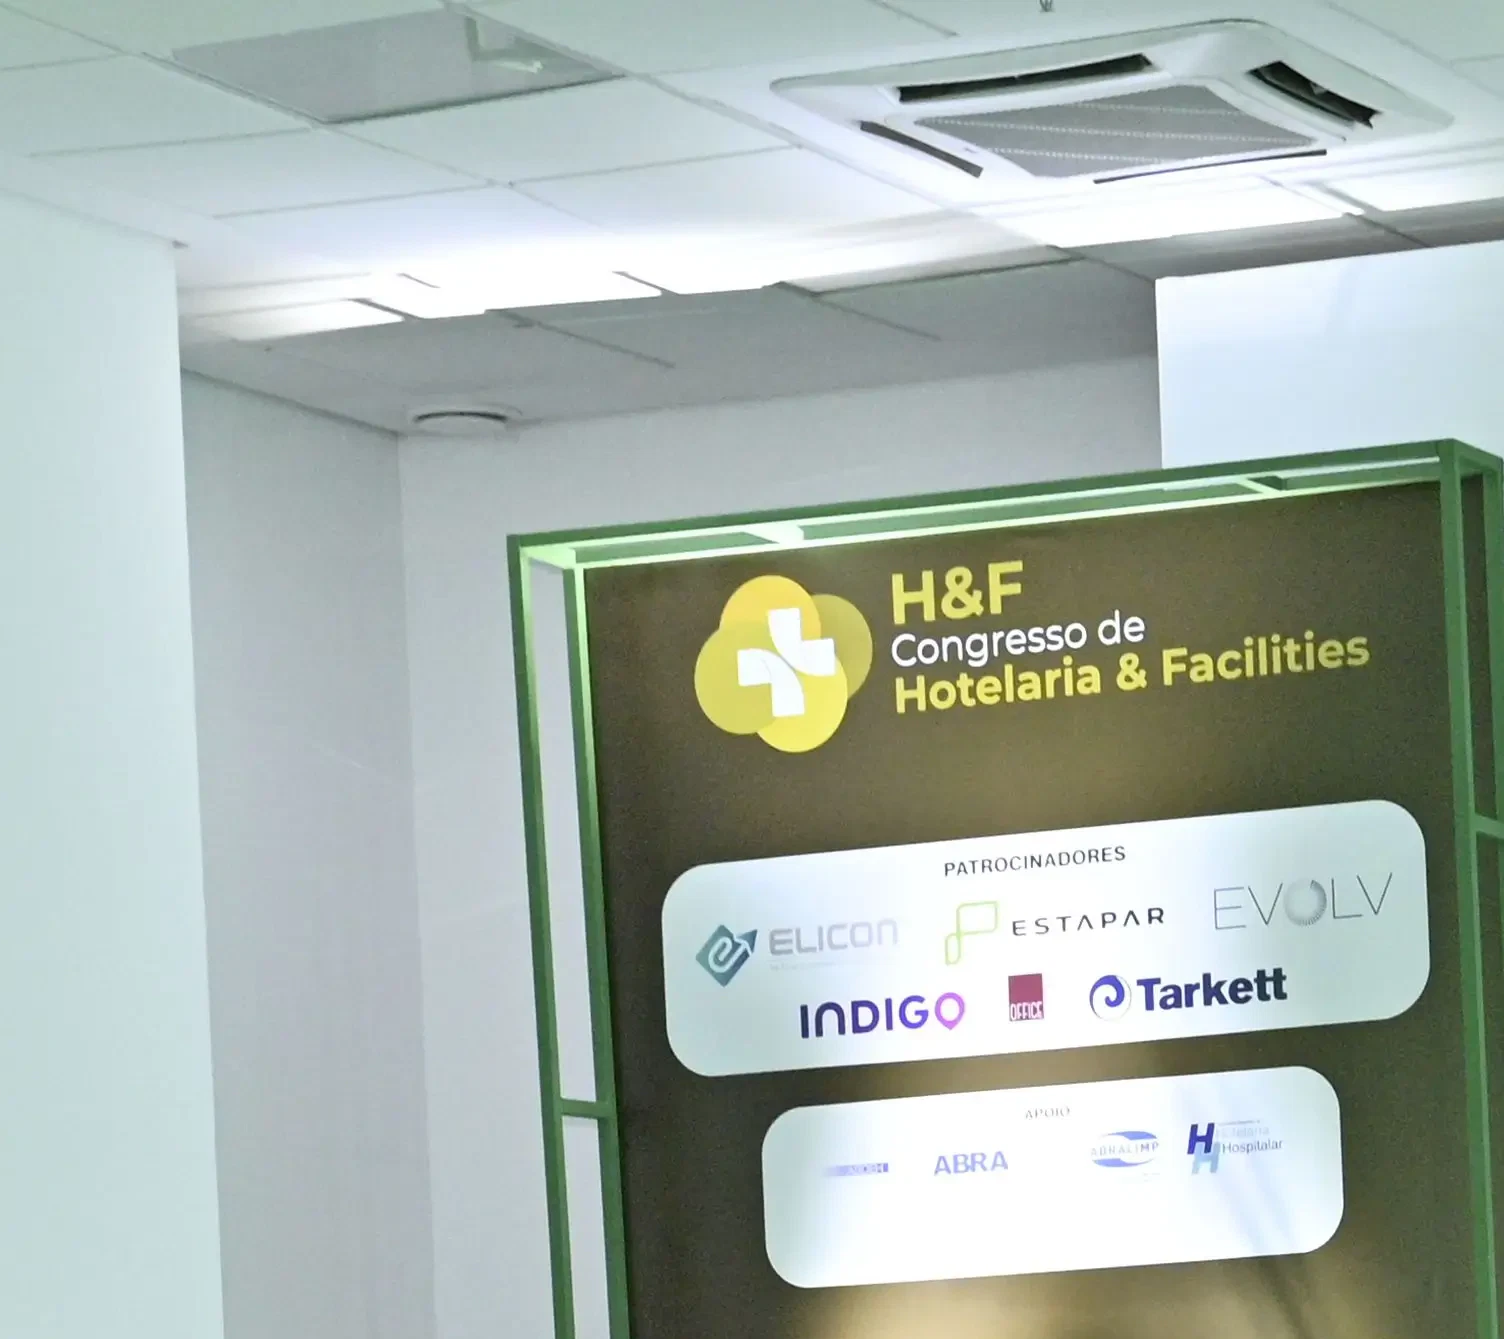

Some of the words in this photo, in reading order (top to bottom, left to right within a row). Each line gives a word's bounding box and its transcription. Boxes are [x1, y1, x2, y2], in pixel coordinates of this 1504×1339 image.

[891, 560, 1025, 625] H&F
[891, 615, 1088, 670] Congresso
[1097, 609, 1146, 647] de
[895, 657, 1102, 714] Hotelaria
[1116, 652, 1148, 692] &
[1162, 630, 1371, 687] Facilities
[943, 844, 1127, 878] PATROCINADORES
[1011, 905, 1165, 938] ESTAPAR
[1213, 872, 1394, 931] EVOLV
[768, 918, 898, 957] ELICON
[1009, 1000, 1043, 1020] OFFICE
[1136, 966, 1289, 1013] Tarkett
[799, 991, 966, 1041] INDIGO
[1223, 1139, 1283, 1154] Hospitalar
